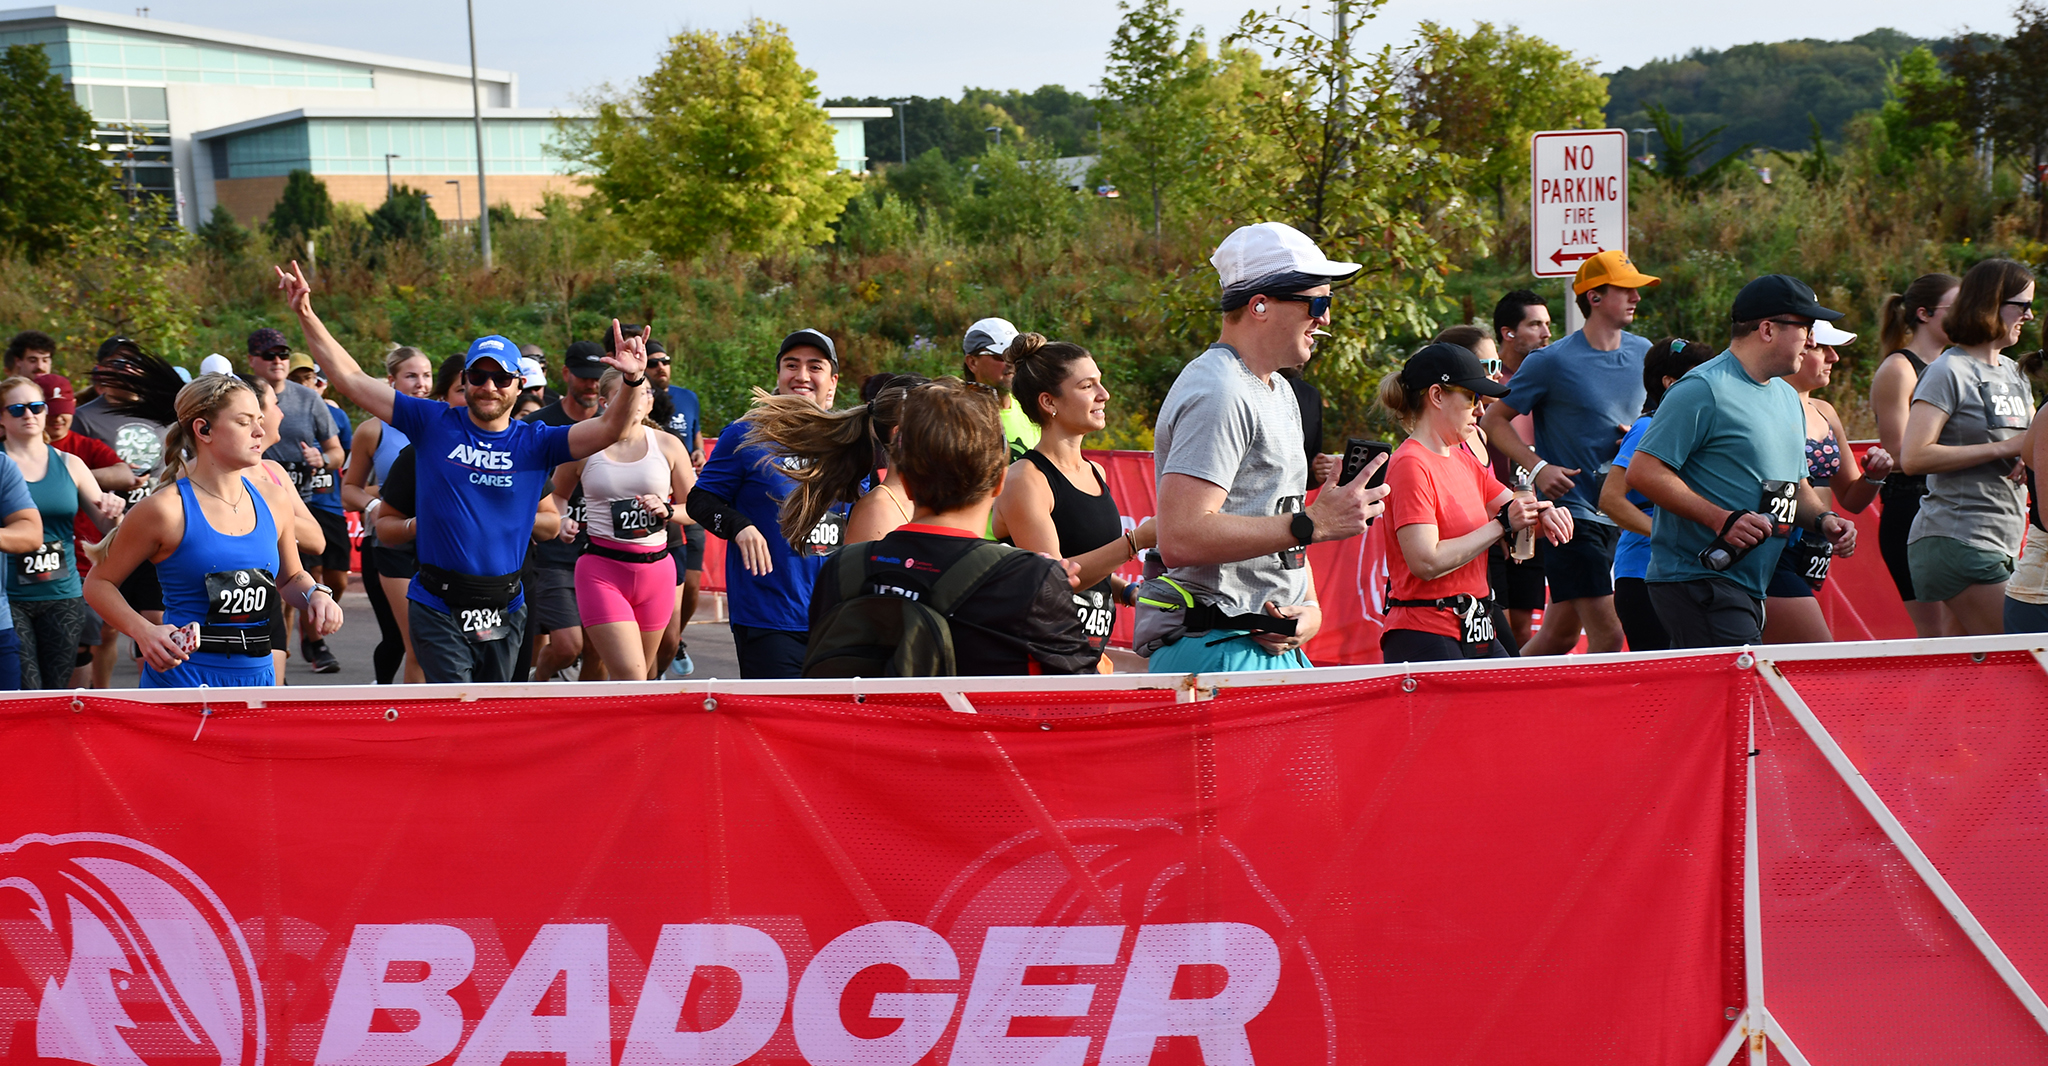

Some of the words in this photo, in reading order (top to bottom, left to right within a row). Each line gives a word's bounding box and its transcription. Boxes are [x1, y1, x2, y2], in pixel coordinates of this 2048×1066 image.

[1564, 144, 1594, 171] NO
[1541, 175, 1618, 204] PARKING
[1564, 207, 1597, 224] FIRE
[1562, 228, 1599, 246] LANE
[1991, 394, 2026, 417] 2510
[447, 443, 514, 470] AYRES
[469, 472, 514, 487] CARES
[23, 552, 60, 574] 2449
[218, 585, 268, 614] 2260
[461, 607, 502, 632] 2334
[313, 919, 1281, 1066] BADGER
